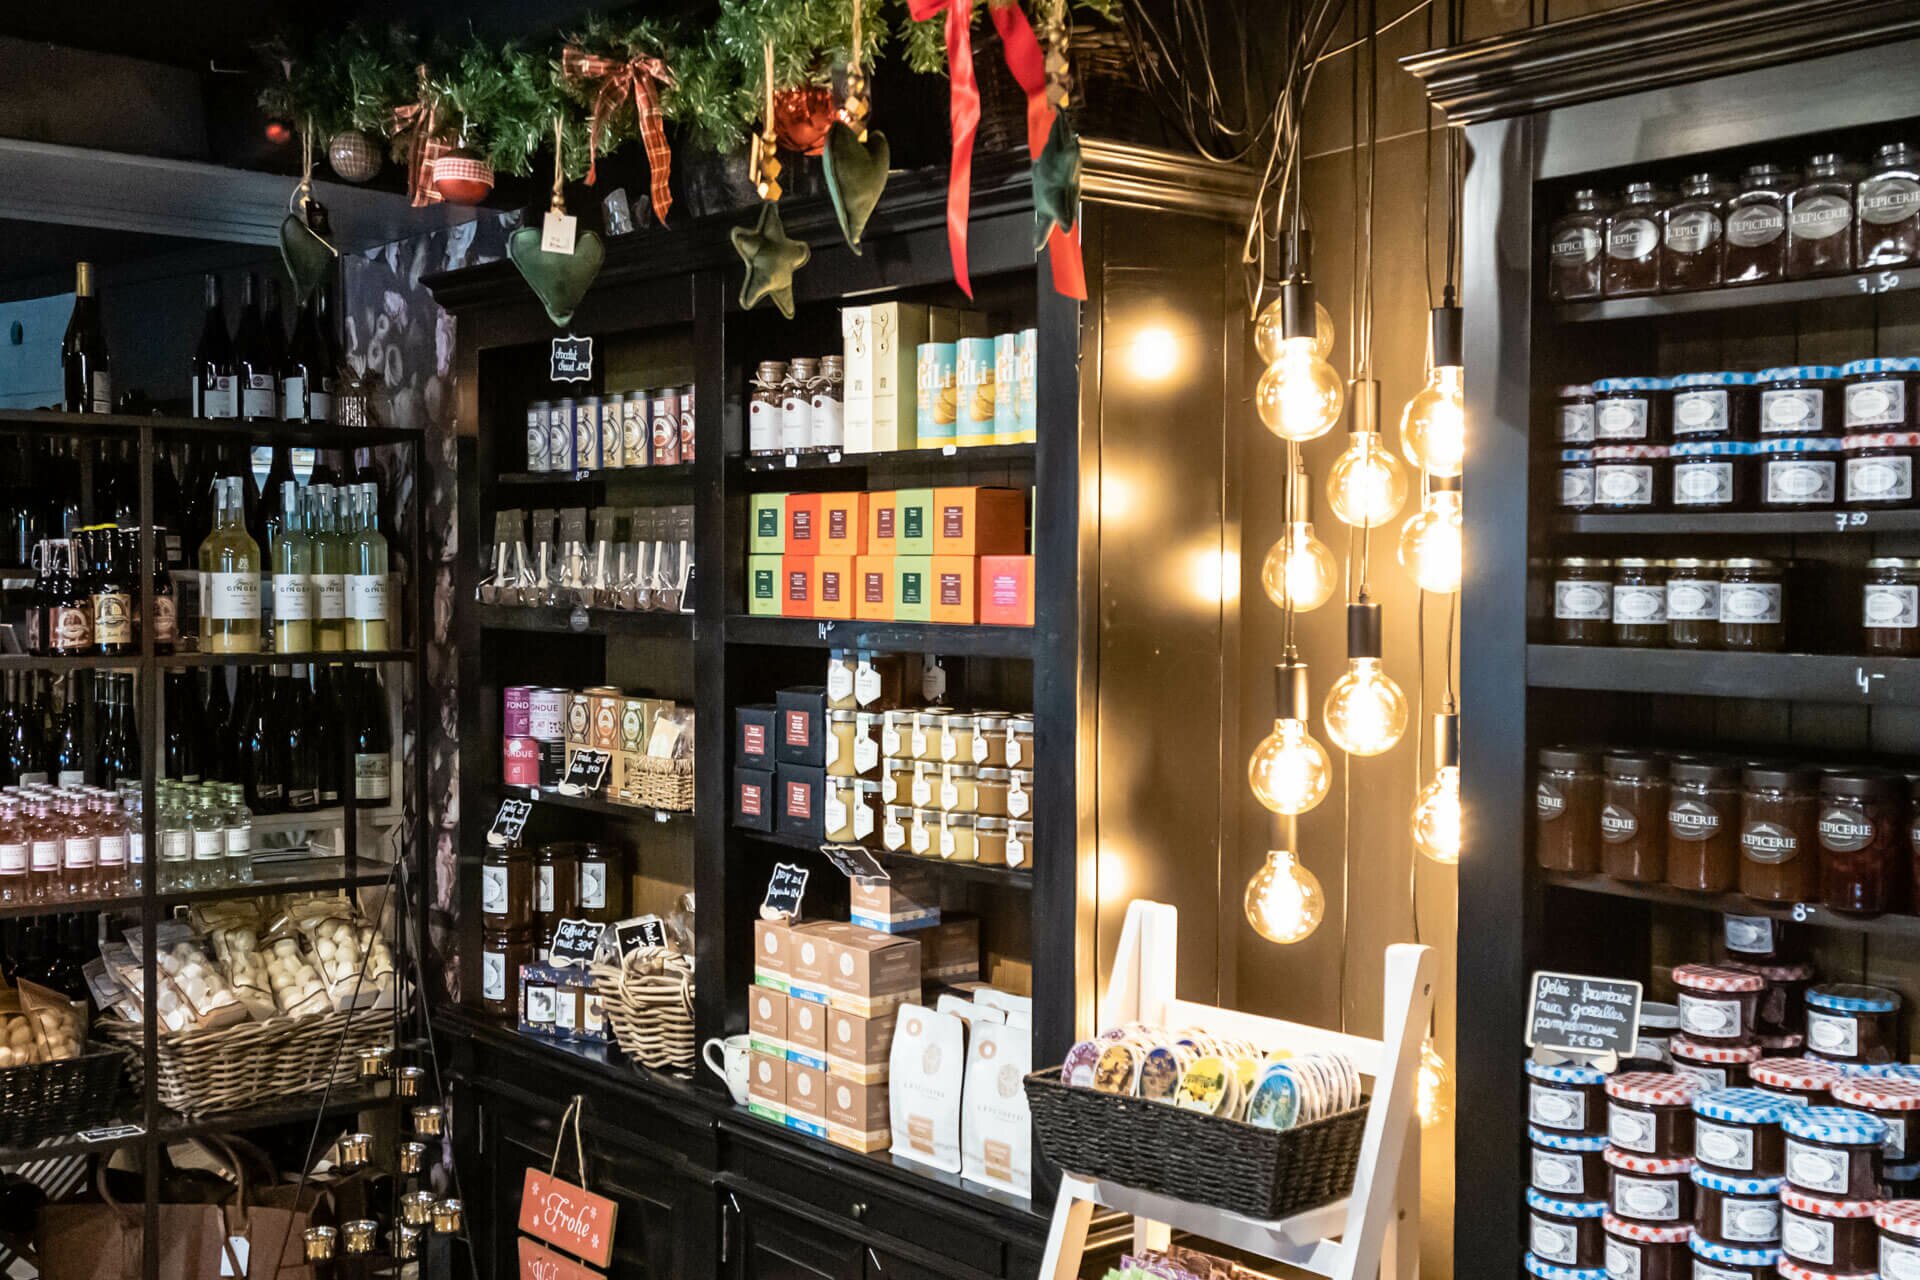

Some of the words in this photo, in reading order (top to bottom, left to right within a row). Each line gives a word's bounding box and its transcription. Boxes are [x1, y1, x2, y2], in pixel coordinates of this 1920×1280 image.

[1728, 216, 1784, 233] L'EPICERIE
[1792, 206, 1849, 226] L'EPICERIE
[506, 700, 529, 710] FOND
[531, 703, 559, 713] ONDUE
[543, 1192, 591, 1238] Frohe
